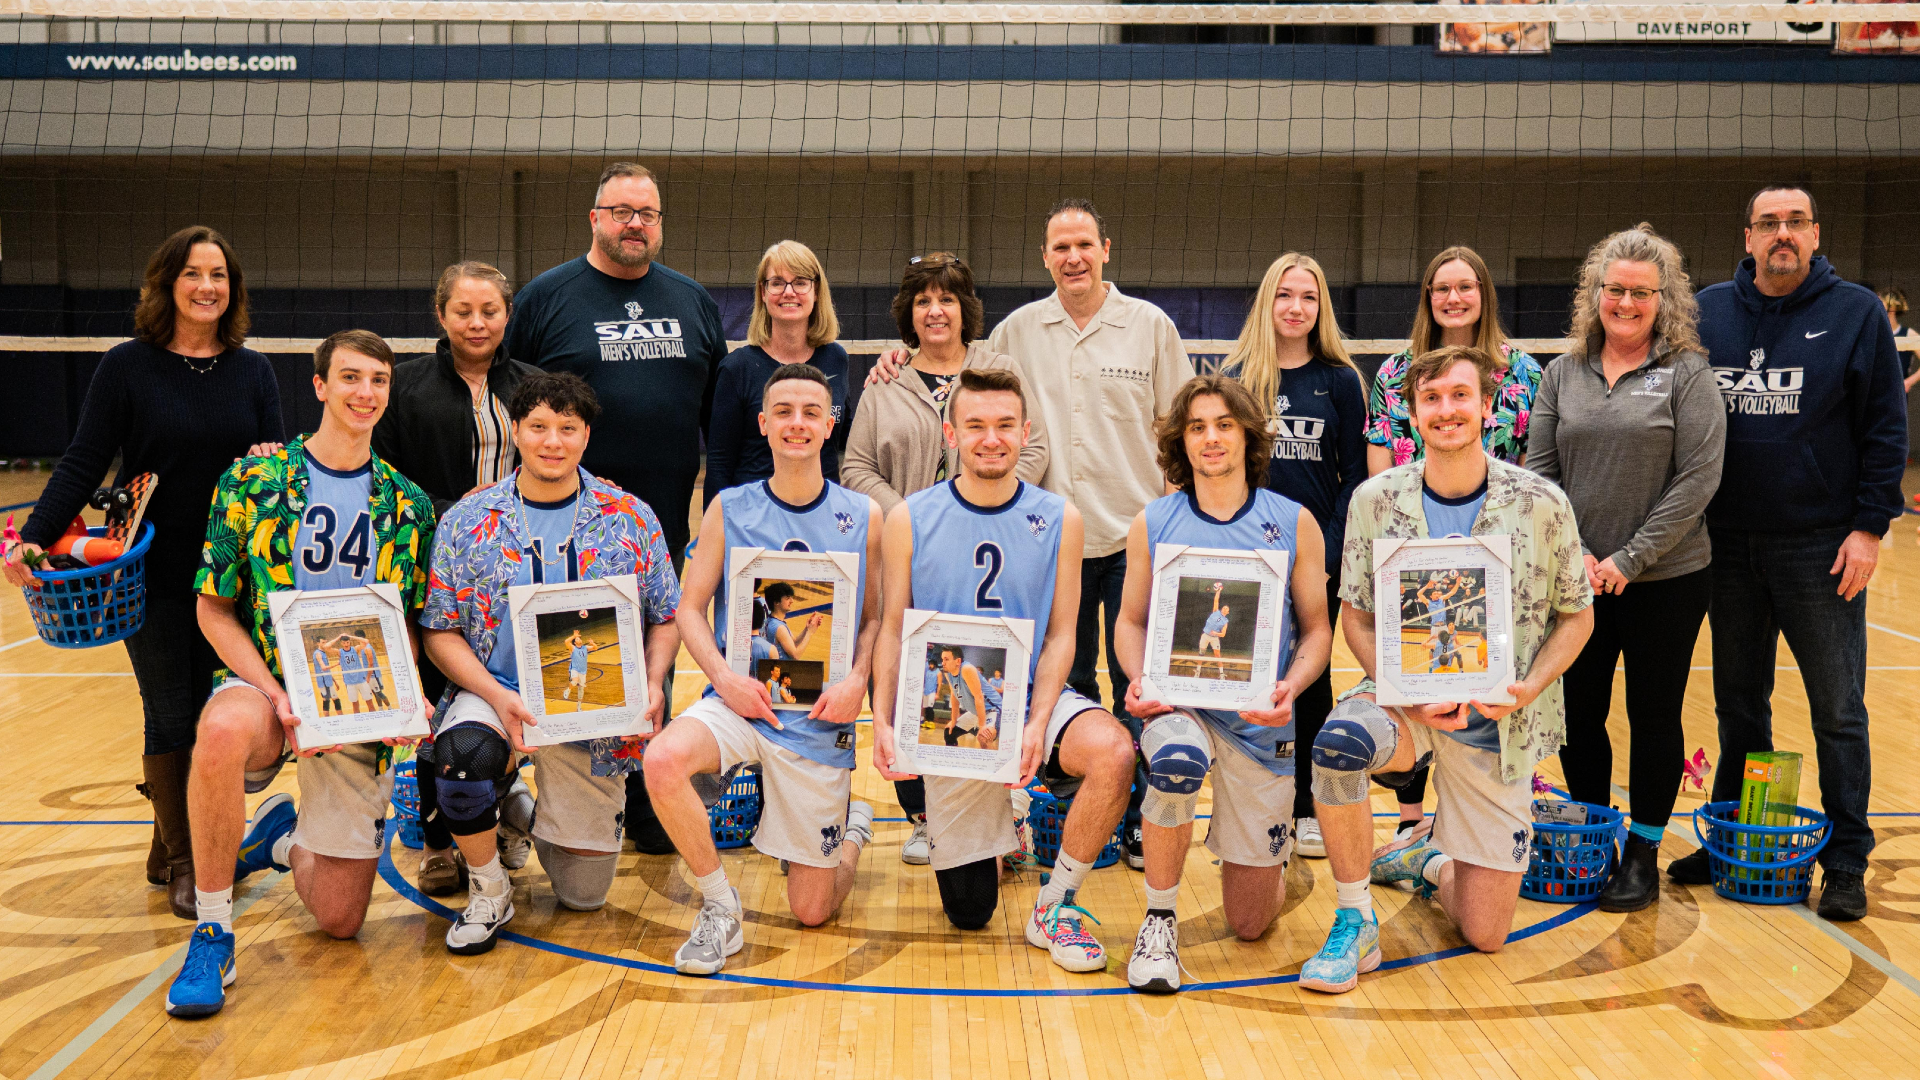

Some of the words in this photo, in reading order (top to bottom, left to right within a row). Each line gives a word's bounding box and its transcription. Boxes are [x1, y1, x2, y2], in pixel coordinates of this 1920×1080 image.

[1637, 22, 1752, 35] DAVENPORT
[66, 48, 297, 71] www.saubees.com
[595, 322, 681, 341] SAU
[600, 344, 631, 361] MEN'S
[631, 341, 687, 360] VOLLEYBALL
[1714, 370, 1804, 392] SAU
[1738, 394, 1800, 415] VOLLEYBALL
[1265, 419, 1325, 440] AU
[302, 503, 374, 580] 34
[974, 540, 1004, 612] 2
